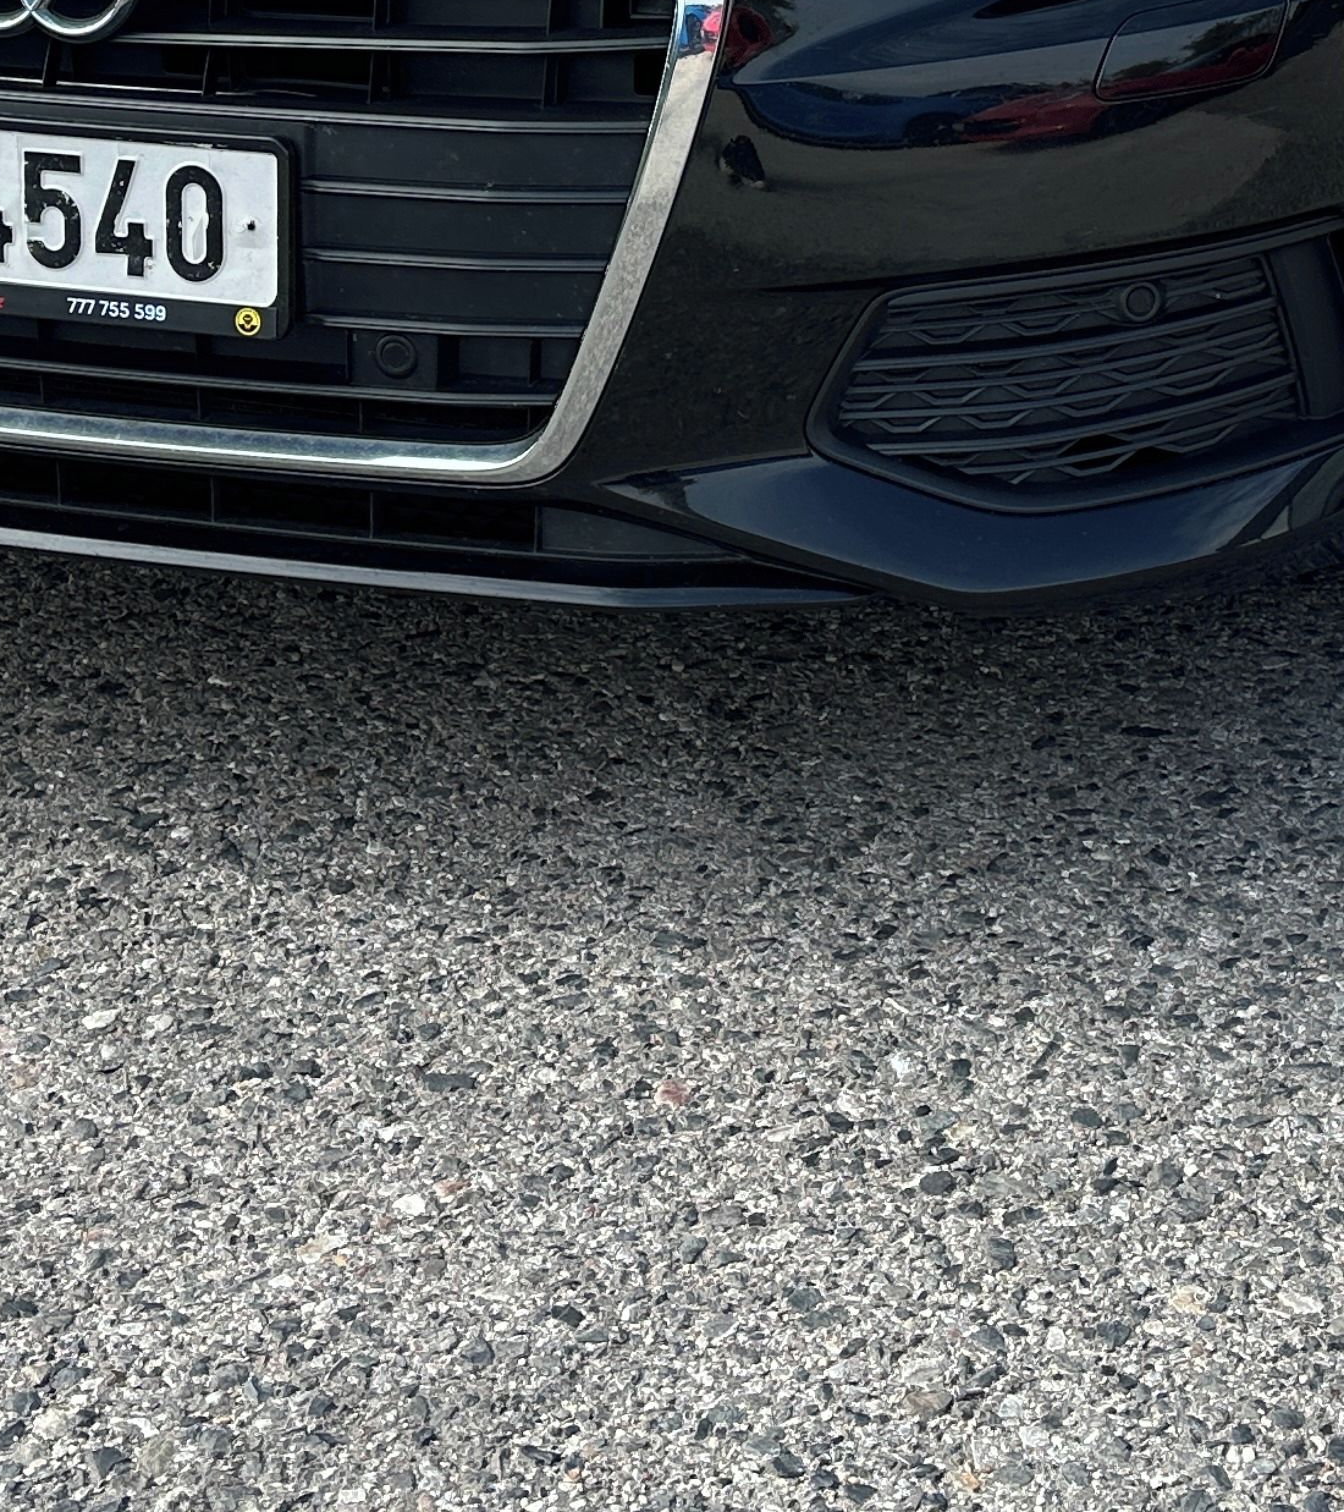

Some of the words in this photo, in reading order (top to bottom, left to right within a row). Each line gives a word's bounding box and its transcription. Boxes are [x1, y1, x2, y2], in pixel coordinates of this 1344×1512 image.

[67, 296, 94, 316] 777
[98, 299, 130, 320] 755
[133, 302, 167, 324] 599
